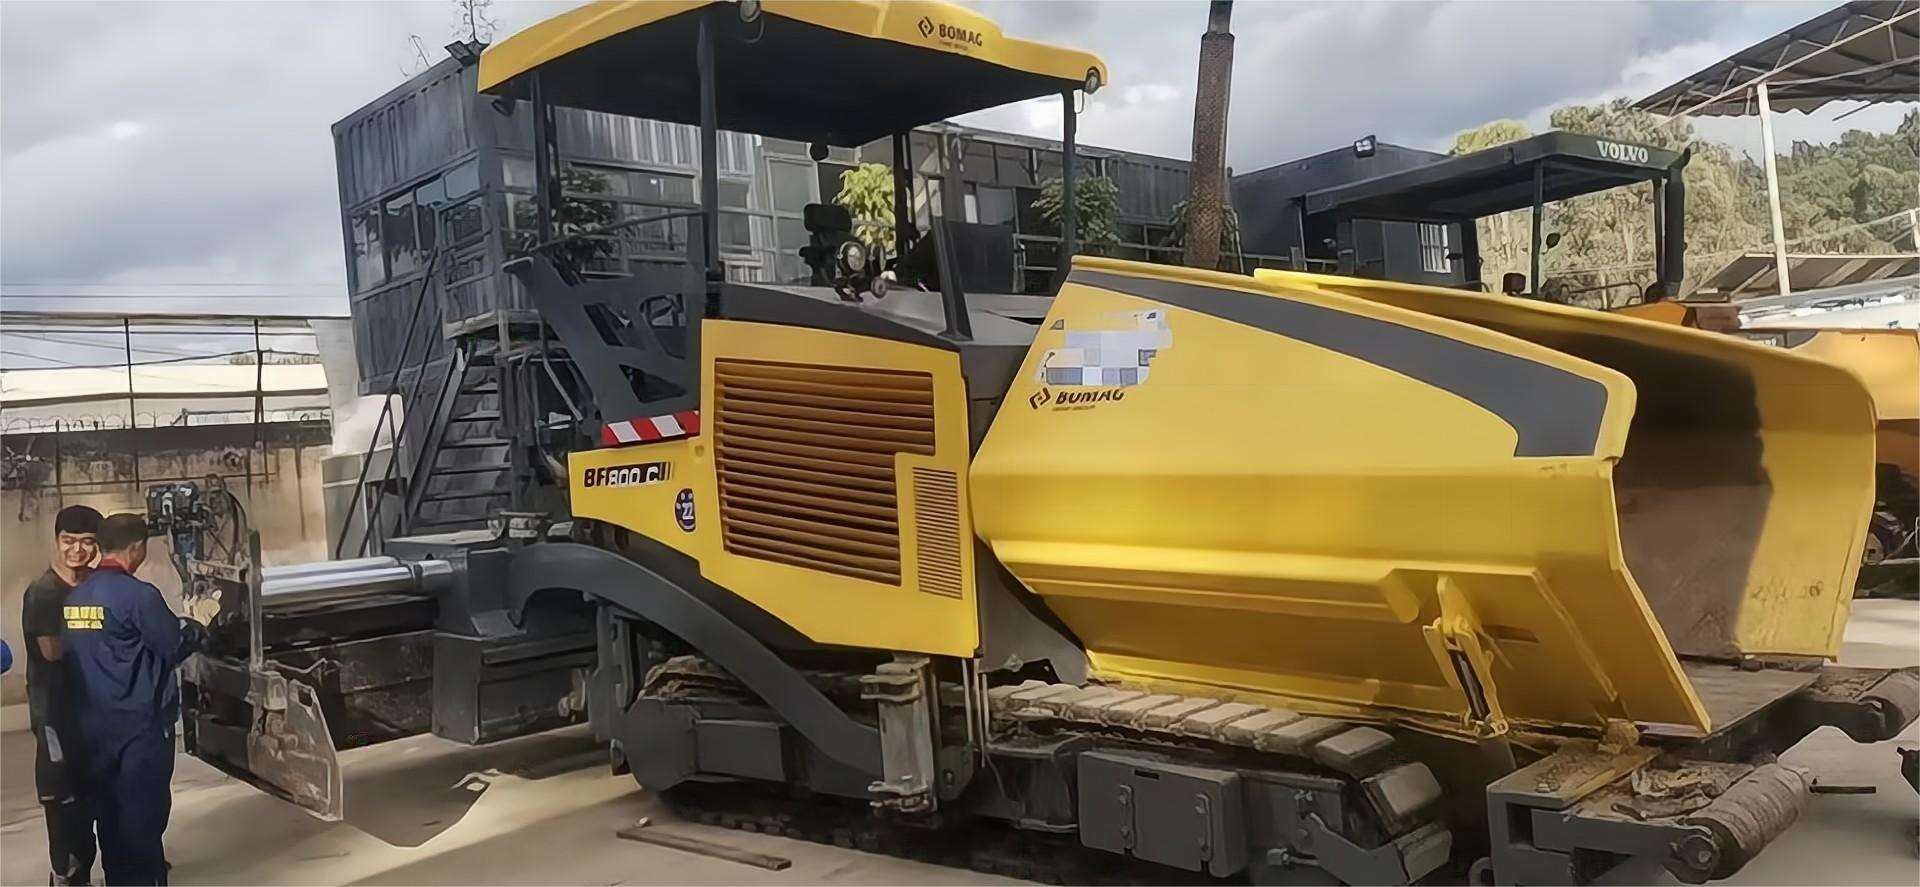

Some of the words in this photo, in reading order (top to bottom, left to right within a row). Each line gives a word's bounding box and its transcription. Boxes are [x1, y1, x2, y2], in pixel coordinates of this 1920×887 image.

[939, 23, 983, 47] BOMAG
[1596, 140, 1648, 163] VOLVO
[1055, 388, 1125, 405] BOMAG
